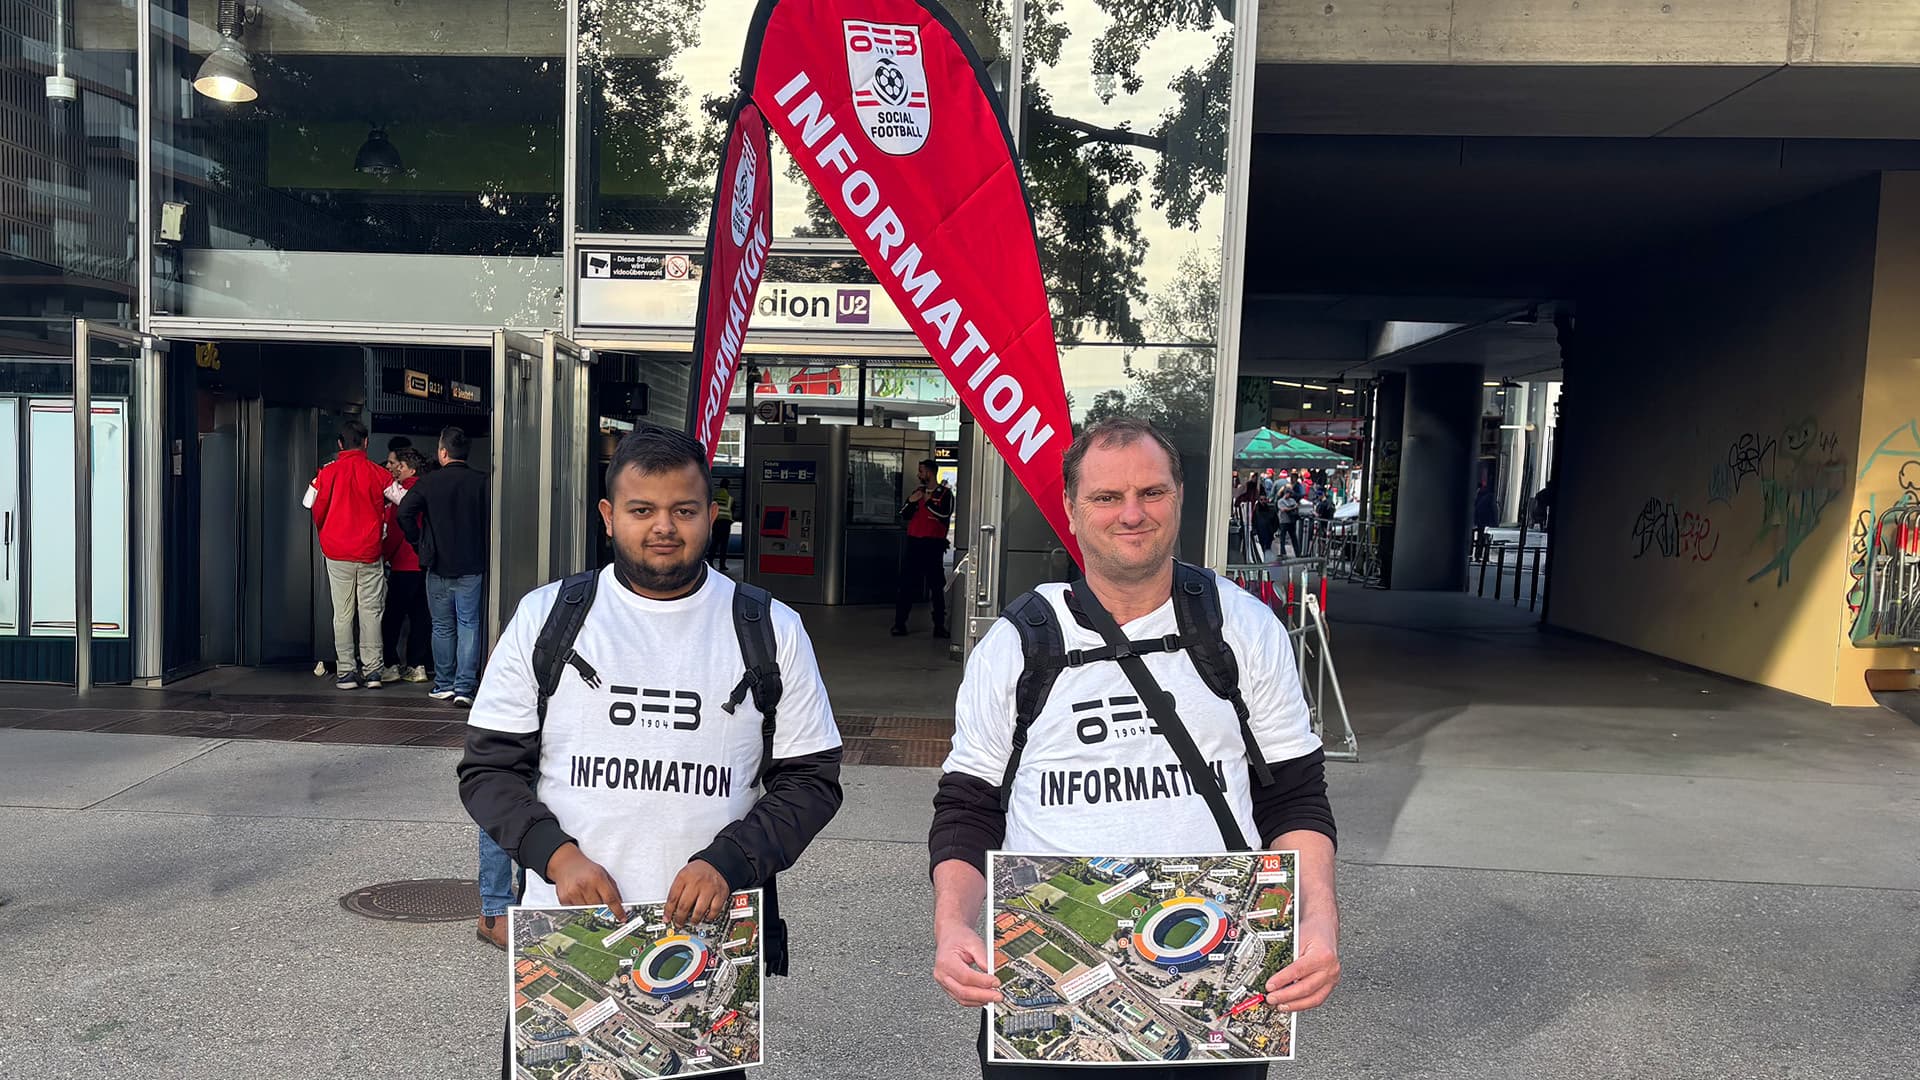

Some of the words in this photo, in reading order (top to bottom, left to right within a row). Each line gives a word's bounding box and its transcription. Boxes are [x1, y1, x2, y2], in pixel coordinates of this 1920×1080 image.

[878, 112, 915, 124] SOCIAL
[871, 125, 923, 138] FOOTBALL
[617, 255, 636, 263] Diese
[613, 268, 663, 276] videoüberwacht
[774, 71, 1055, 465] INFORMATION
[756, 289, 830, 317] dion
[839, 295, 868, 316] U2
[700, 211, 768, 454] NFORMATION
[641, 718, 669, 729] 1904
[1114, 726, 1146, 739] 1904
[570, 755, 732, 798] INFORMATION
[1040, 760, 1228, 806] INFORMATIN
[1265, 859, 1279, 870] U3
[1209, 1034, 1223, 1043] U2
